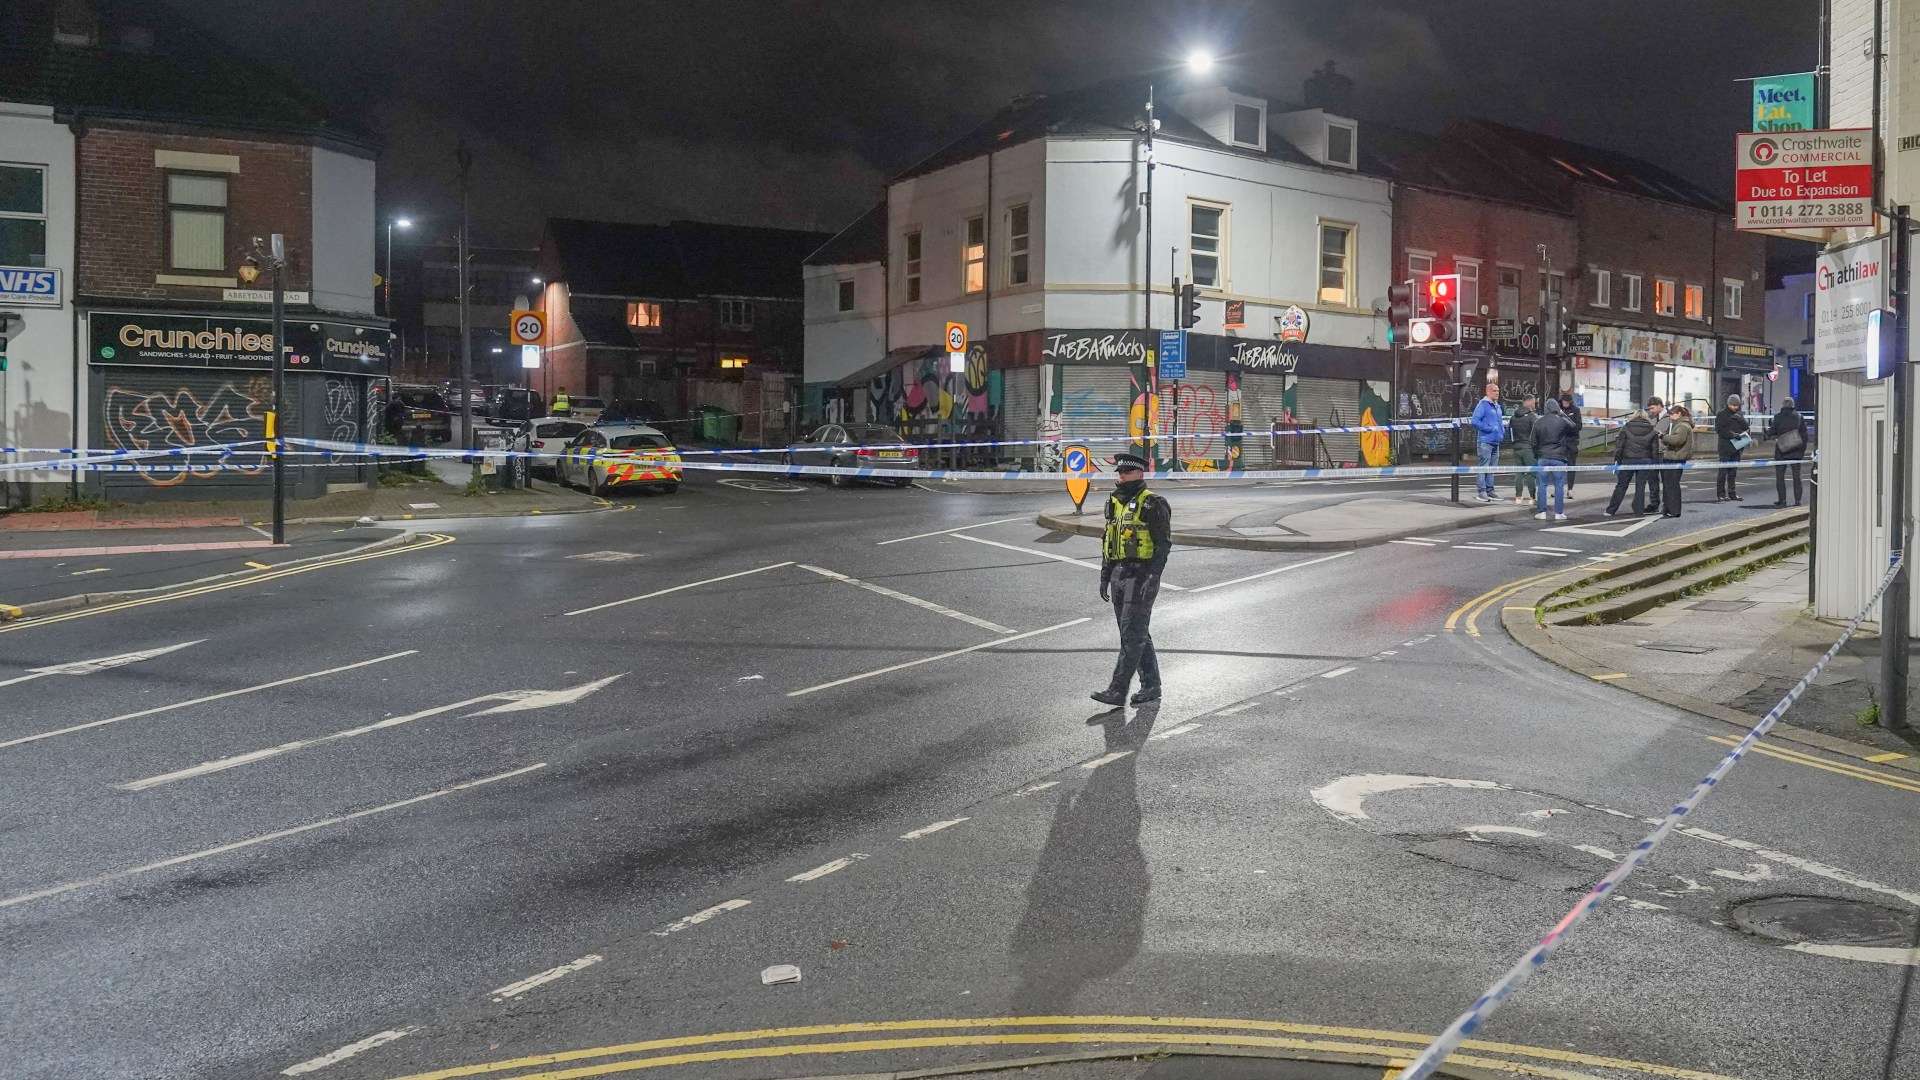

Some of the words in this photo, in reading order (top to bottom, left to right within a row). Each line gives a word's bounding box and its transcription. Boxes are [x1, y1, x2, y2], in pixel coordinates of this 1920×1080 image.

[1758, 88, 1806, 104] Meet,
[1782, 136, 1862, 151] Crosthwaite
[1782, 152, 1861, 163] COMMERCIAL
[1782, 170, 1799, 183] To
[1805, 170, 1827, 183] Let
[1751, 186, 1776, 198] Due
[1780, 186, 1792, 197] to
[1796, 184, 1858, 199] Expansion
[1748, 206, 1757, 217] T
[1761, 205, 1792, 217] 0114
[1798, 204, 1823, 216] 272
[1828, 203, 1863, 215] 3888
[1747, 215, 1864, 225] www.crosthwaitecommercial.com
[1837, 260, 1880, 285] athilaw
[0, 271, 52, 293] NHS
[227, 291, 272, 300] ABBEYDALE
[1821, 309, 1838, 323] 0114
[1841, 304, 1854, 320] 255
[519, 322, 539, 334] 20
[1460, 326, 1484, 340] ESS
[950, 332, 962, 344] 20
[138, 350, 184, 358] SANDWICHES
